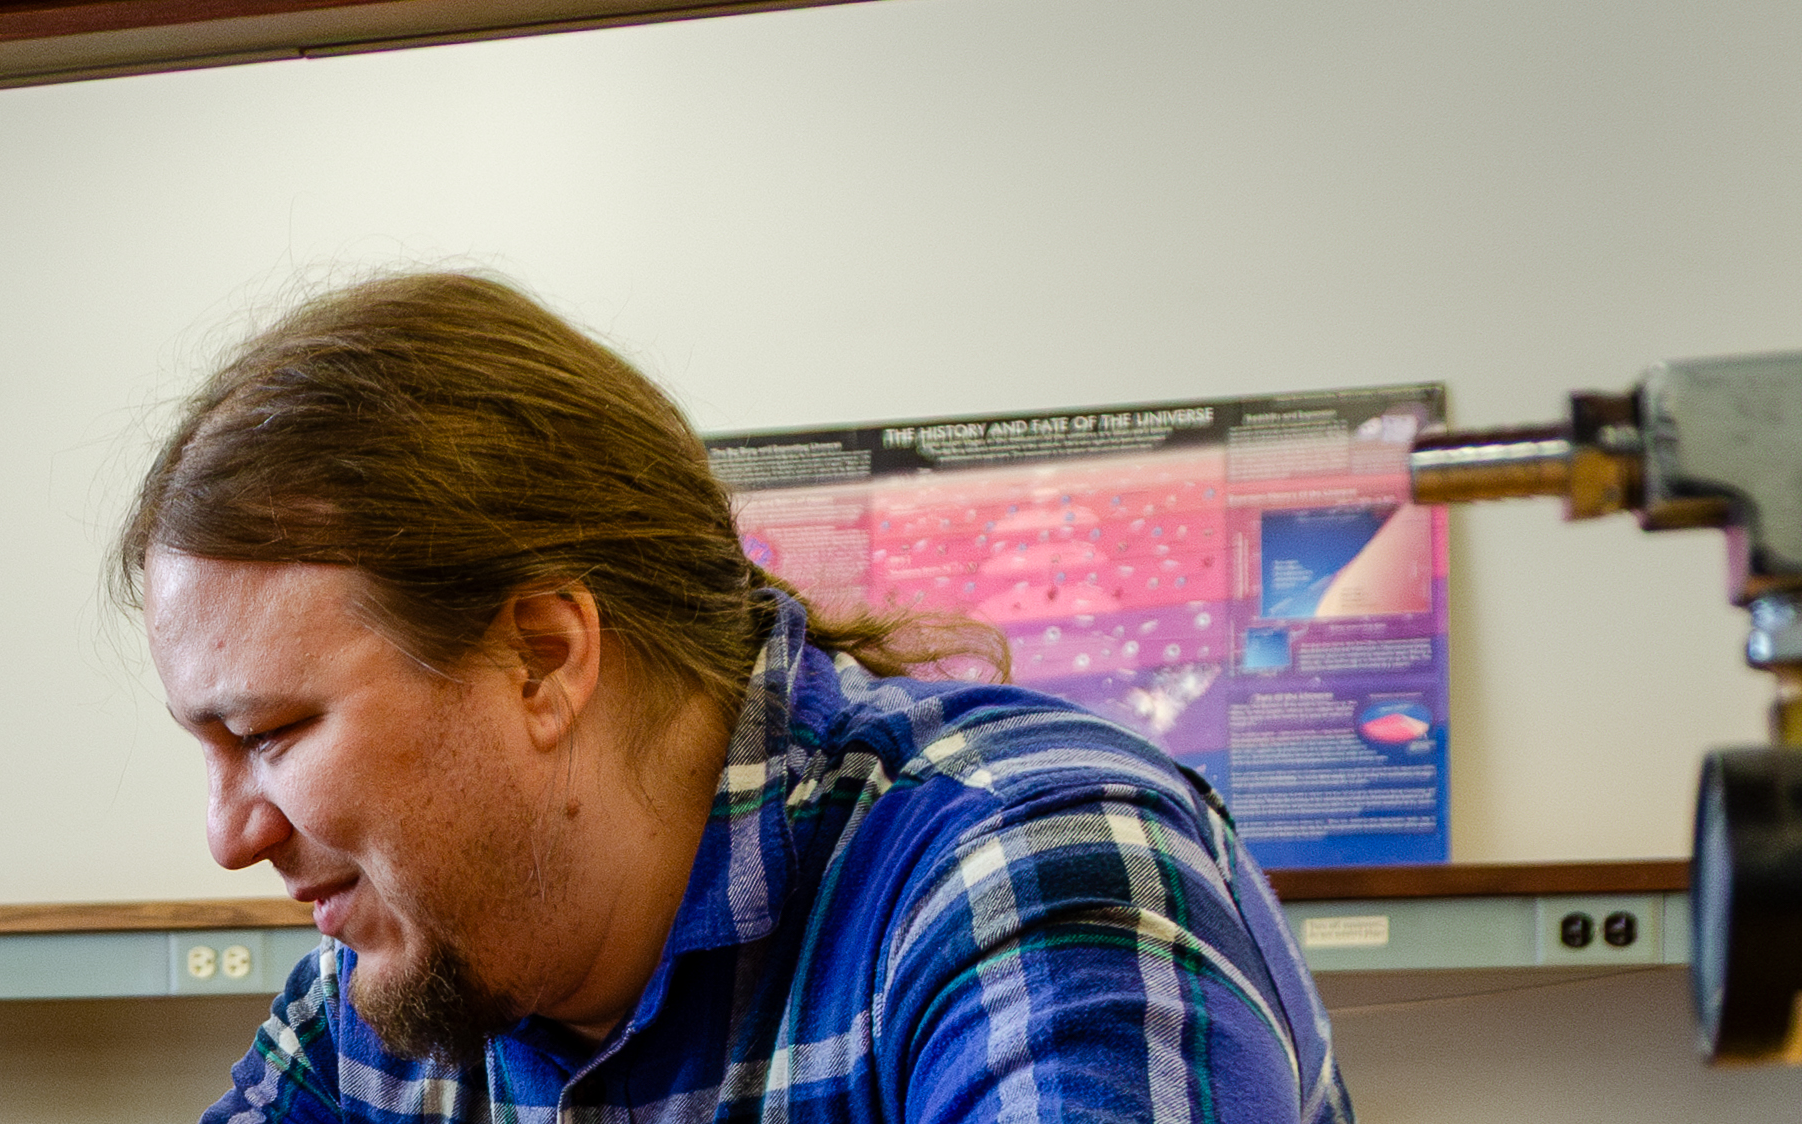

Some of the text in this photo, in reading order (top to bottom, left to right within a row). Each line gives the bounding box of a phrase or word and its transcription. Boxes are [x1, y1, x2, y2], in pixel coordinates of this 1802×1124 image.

[883, 426, 915, 449] THE
[918, 422, 988, 443] HISTORY
[987, 418, 1029, 438] AND
[1029, 417, 1070, 435] FATE
[1070, 414, 1098, 431] OF
[1100, 411, 1133, 431] THE
[1134, 406, 1214, 428] UNIVERSE
